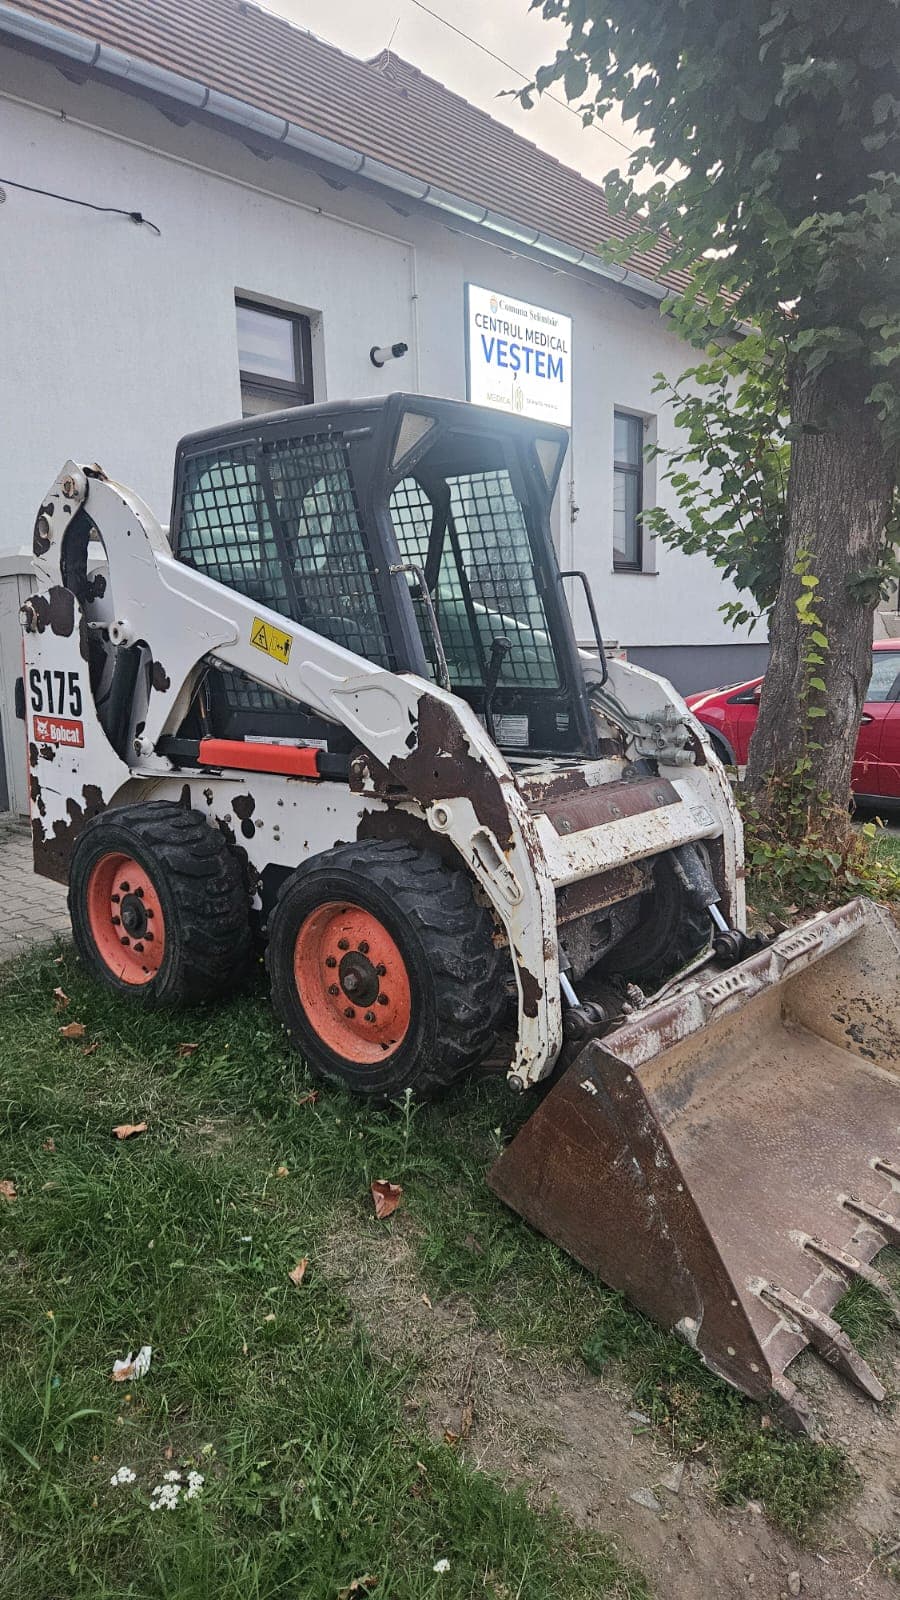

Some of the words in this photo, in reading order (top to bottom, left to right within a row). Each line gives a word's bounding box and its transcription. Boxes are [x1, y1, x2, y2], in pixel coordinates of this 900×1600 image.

[474, 313, 523, 340] CENTRUL
[525, 328, 568, 354] MEDICAL
[29, 668, 83, 717] S175
[49, 724, 81, 743] Bobcat
